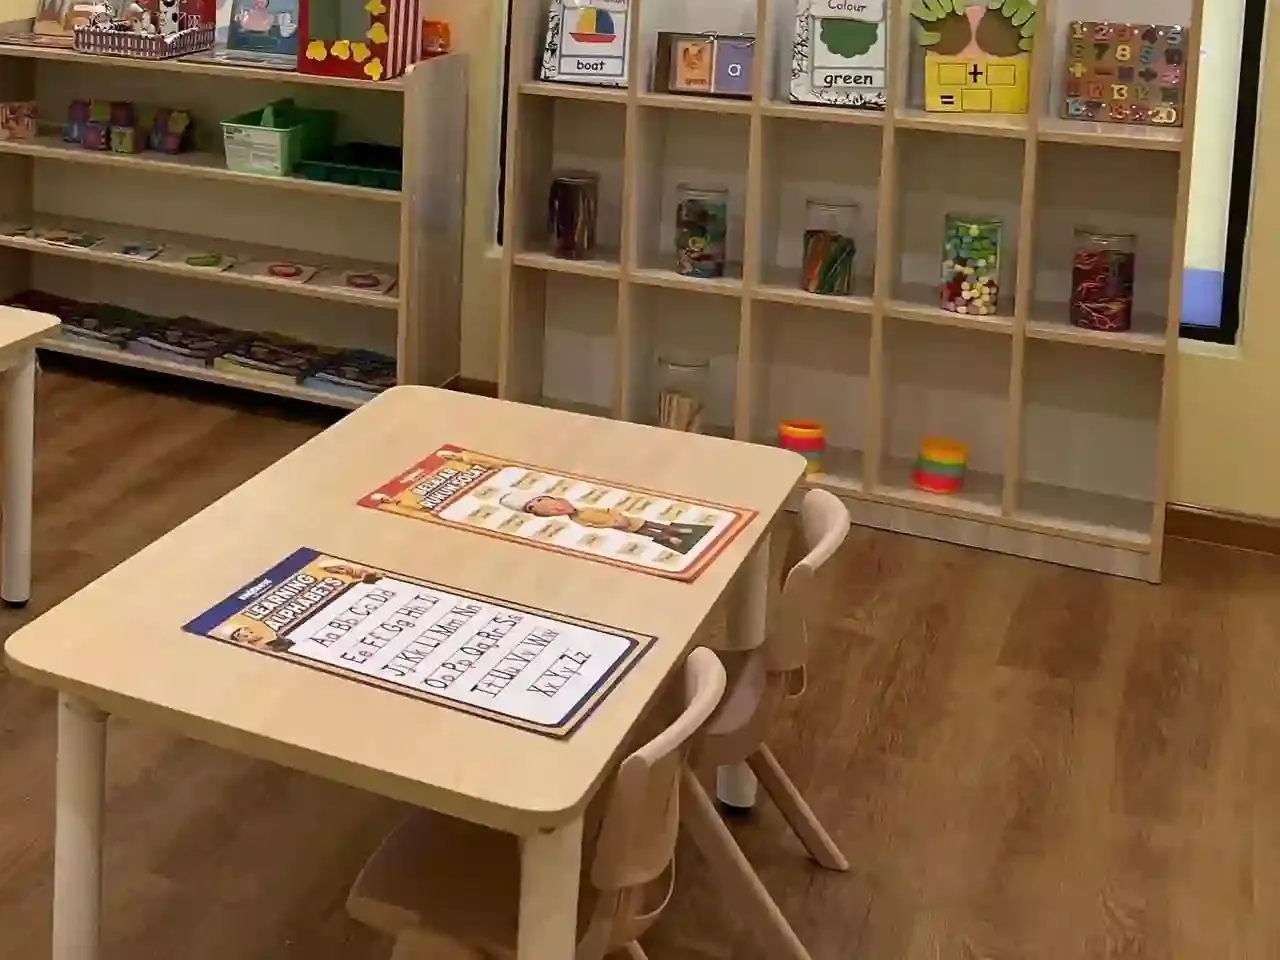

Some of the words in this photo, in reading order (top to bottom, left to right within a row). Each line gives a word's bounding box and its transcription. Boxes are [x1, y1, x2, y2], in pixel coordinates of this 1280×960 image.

[1115, 44, 1131, 61] 8
[576, 59, 606, 72] boat
[823, 71, 873, 88] green
[243, 572, 317, 620] LEARNING
[263, 576, 345, 632] ALPHABETS
[309, 631, 341, 648] Aa
[329, 618, 360, 633] Bb
[340, 650, 373, 664] Ee
[380, 619, 416, 632] Gg
[441, 659, 476, 673] Pp
[559, 650, 592, 665] Zz
[542, 666, 582, 681] Yy
[526, 682, 562, 698] Xx
